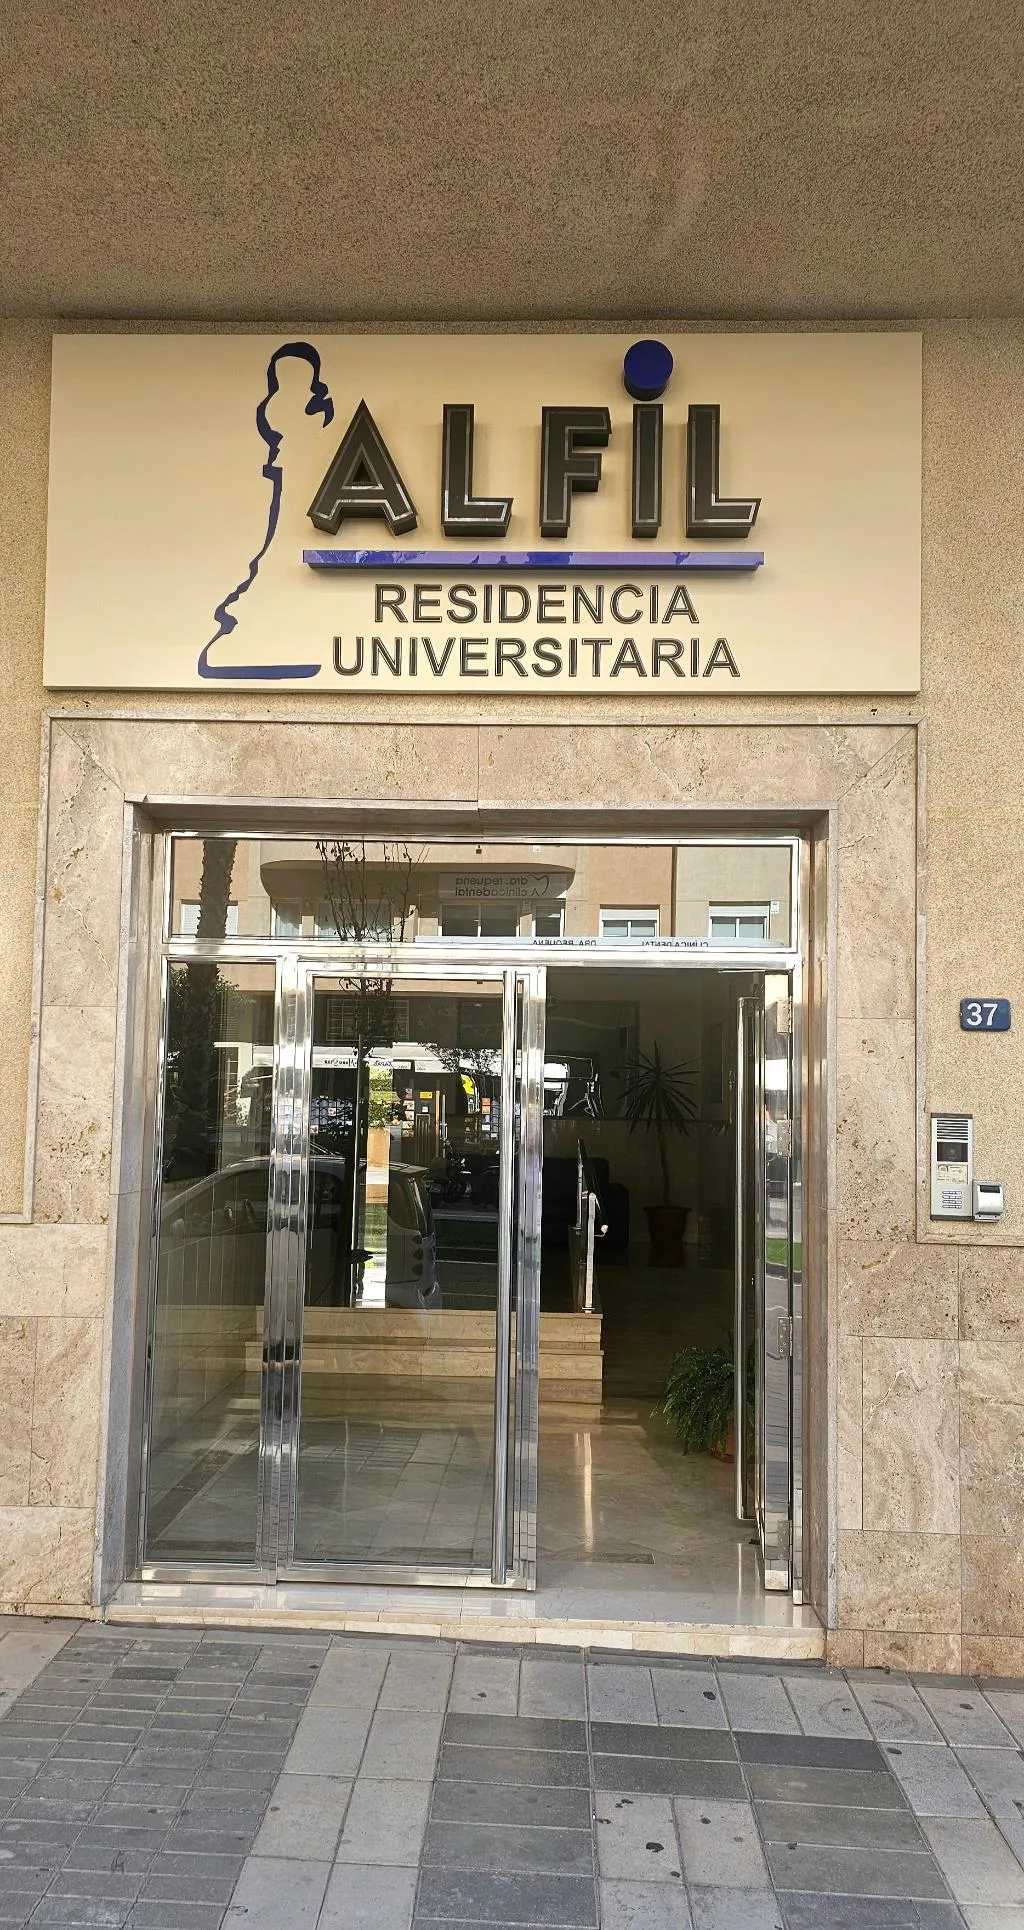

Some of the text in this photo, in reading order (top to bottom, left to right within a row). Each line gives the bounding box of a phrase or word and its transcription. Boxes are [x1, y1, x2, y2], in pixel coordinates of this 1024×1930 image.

[375, 584, 700, 624] RESIDENCIA
[333, 636, 742, 678] UNIVERSITARIA
[966, 1003, 998, 1026] 37
